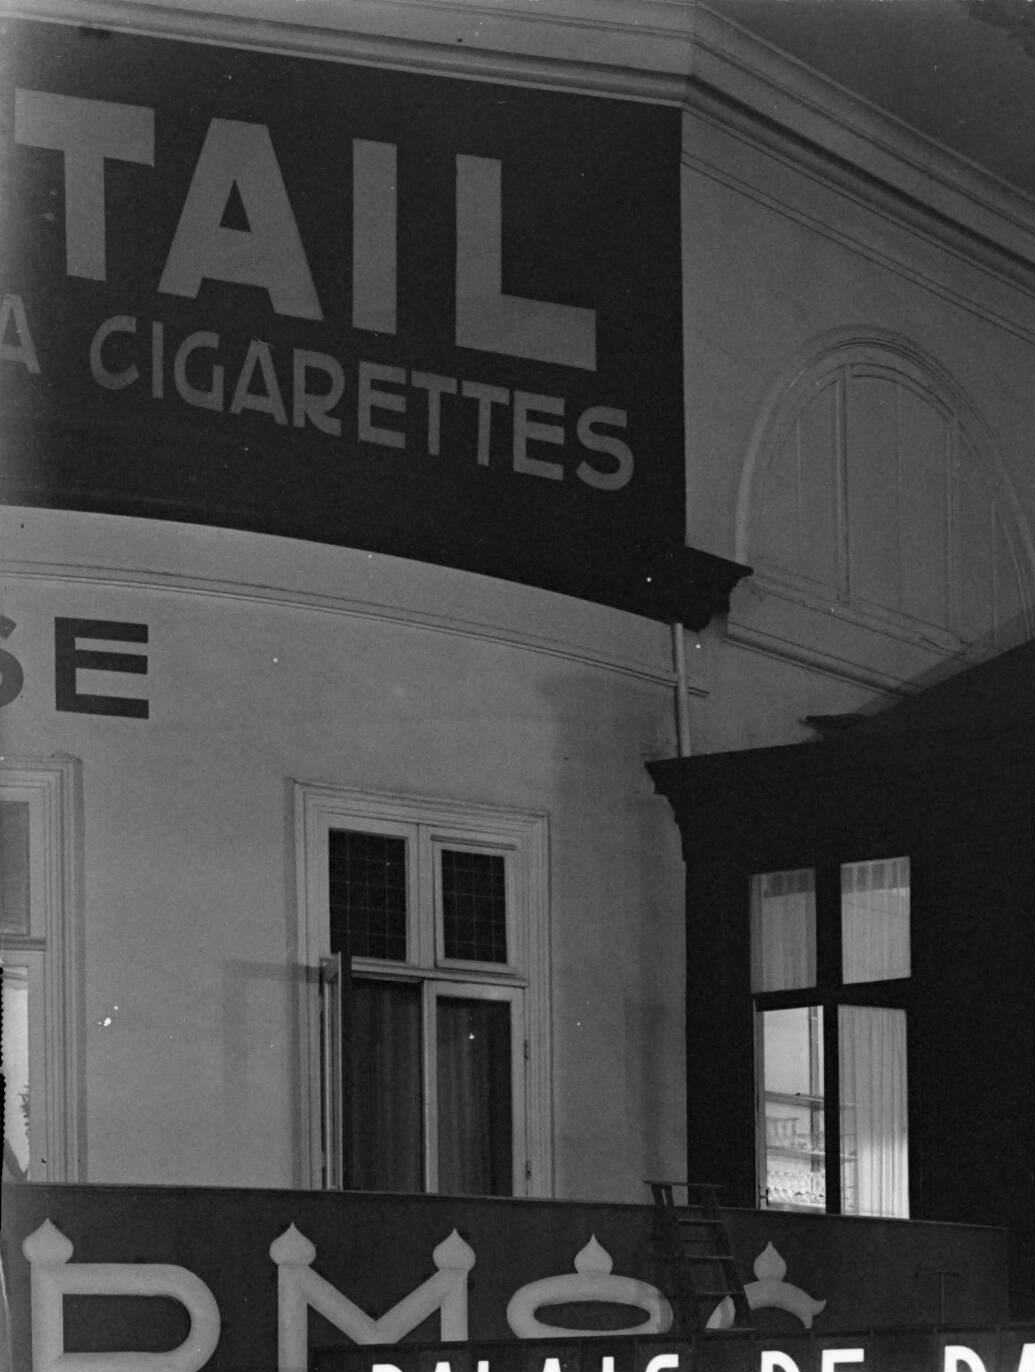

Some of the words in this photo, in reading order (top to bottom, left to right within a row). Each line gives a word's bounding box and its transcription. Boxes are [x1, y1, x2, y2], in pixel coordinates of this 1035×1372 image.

[15, 87, 597, 372] TAIL
[0, 293, 41, 375] A
[89, 313, 635, 491] CIGARETTES
